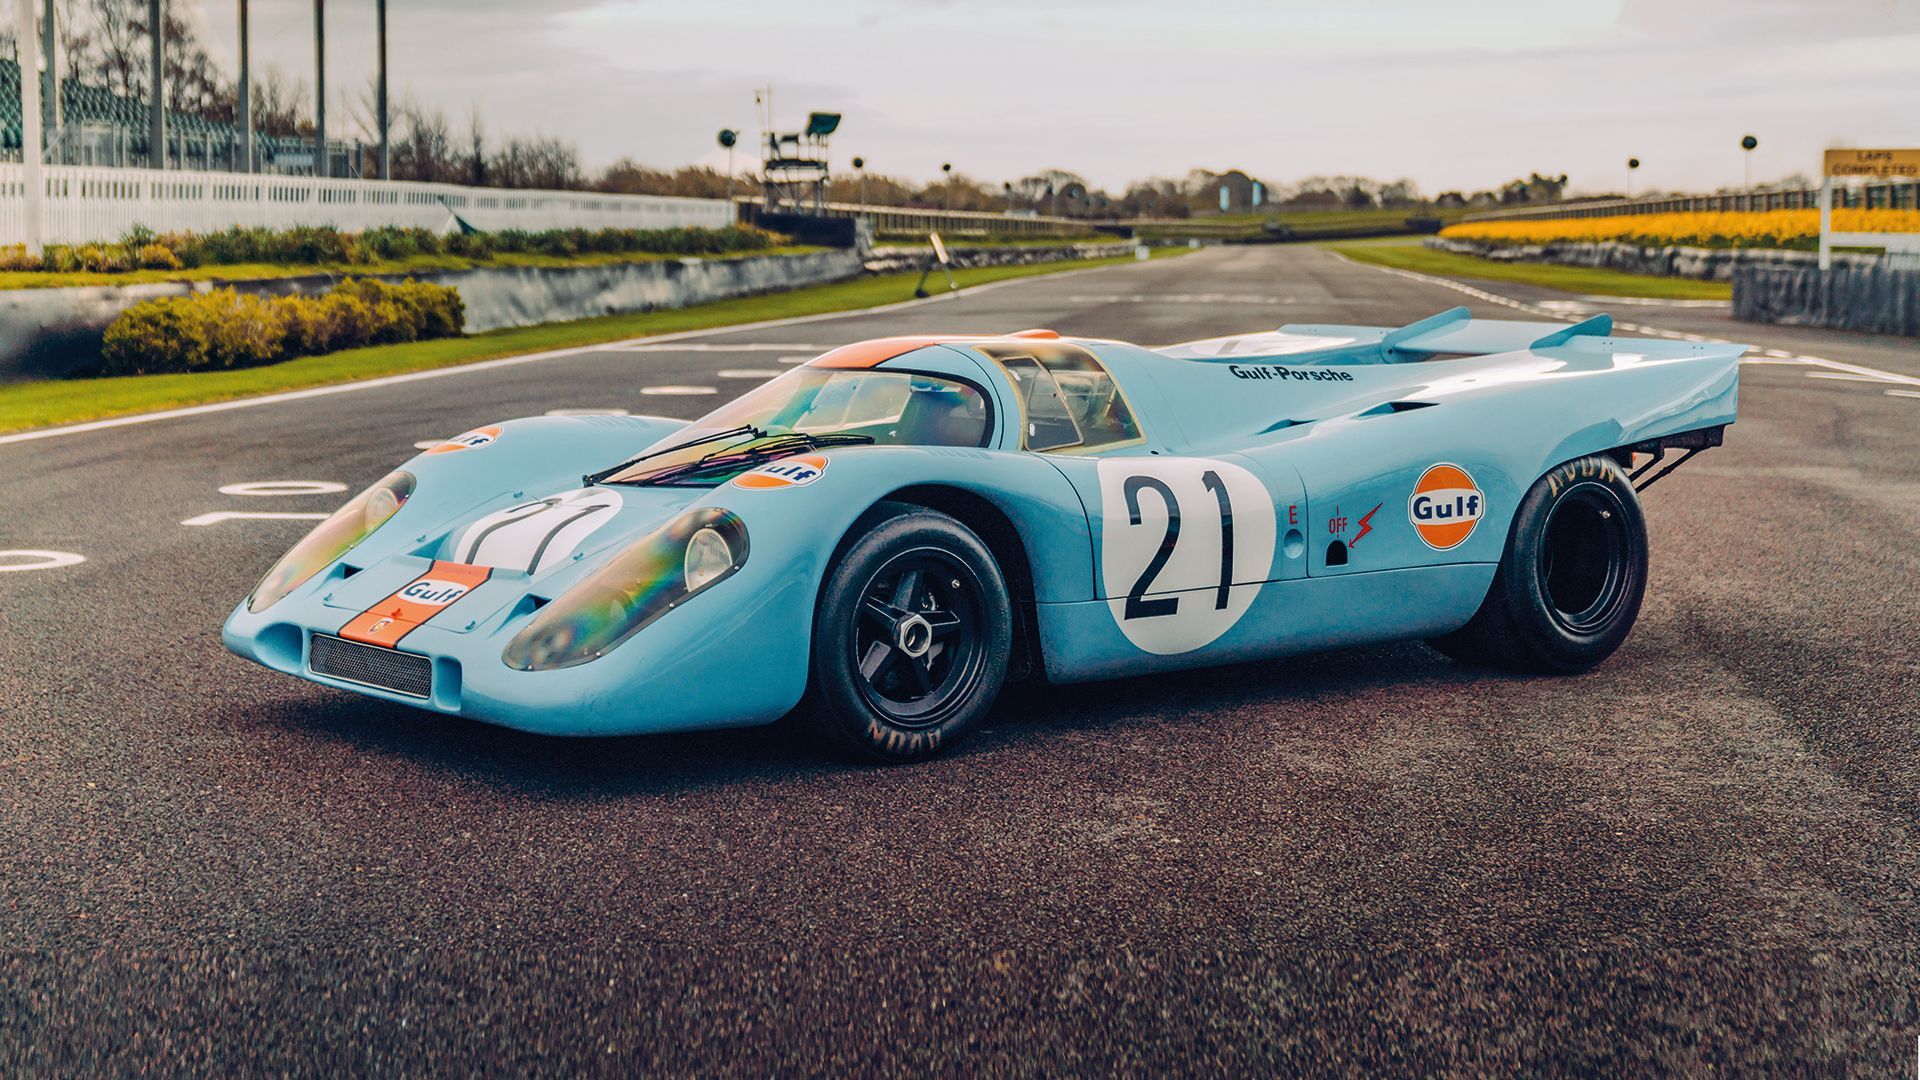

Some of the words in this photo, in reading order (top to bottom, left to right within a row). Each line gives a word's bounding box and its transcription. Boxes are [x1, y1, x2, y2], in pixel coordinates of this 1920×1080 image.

[1229, 365, 1354, 381] Gulf-Porsche
[1546, 457, 1615, 498] AVON
[1289, 505, 1298, 525] E
[1413, 495, 1479, 519] Gulf
[1328, 517, 1348, 534] OFF
[1123, 470, 1233, 620] 21
[404, 582, 463, 602] Gulf
